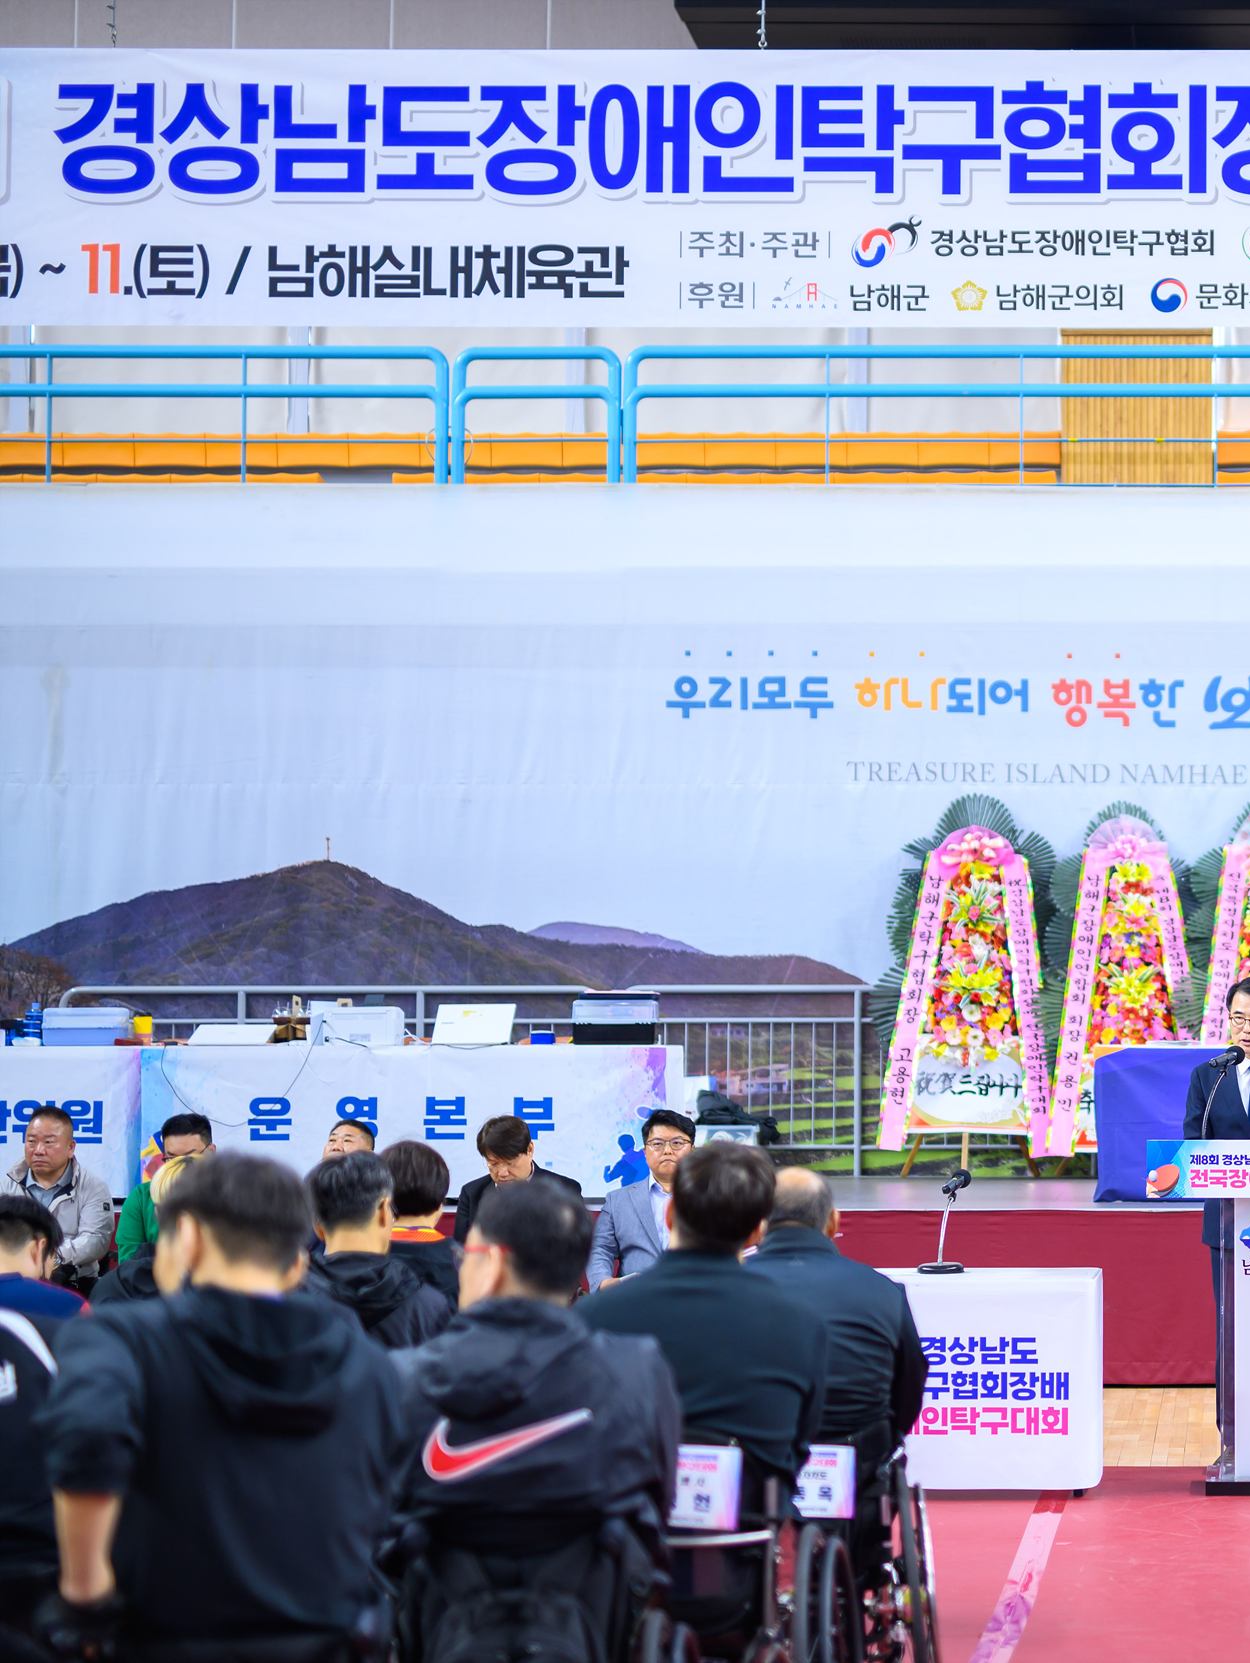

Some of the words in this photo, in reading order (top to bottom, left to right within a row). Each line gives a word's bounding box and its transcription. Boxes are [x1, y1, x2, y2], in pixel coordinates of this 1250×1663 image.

[930, 229, 1217, 257] 경상남도장애인탁구협회
[267, 244, 629, 299] 남해실내체육관
[849, 284, 931, 311] 남해군
[996, 284, 1125, 311] 남해군의회
[665, 675, 834, 719] 우리모두
[854, 676, 1029, 716] 하나되어
[1051, 678, 1185, 728] 행복한
[846, 760, 997, 784] TREASURE
[1005, 762, 1111, 785] ISLAND
[1120, 763, 1248, 786] NAMHAE
[1190, 1154, 1219, 1166] 제8회
